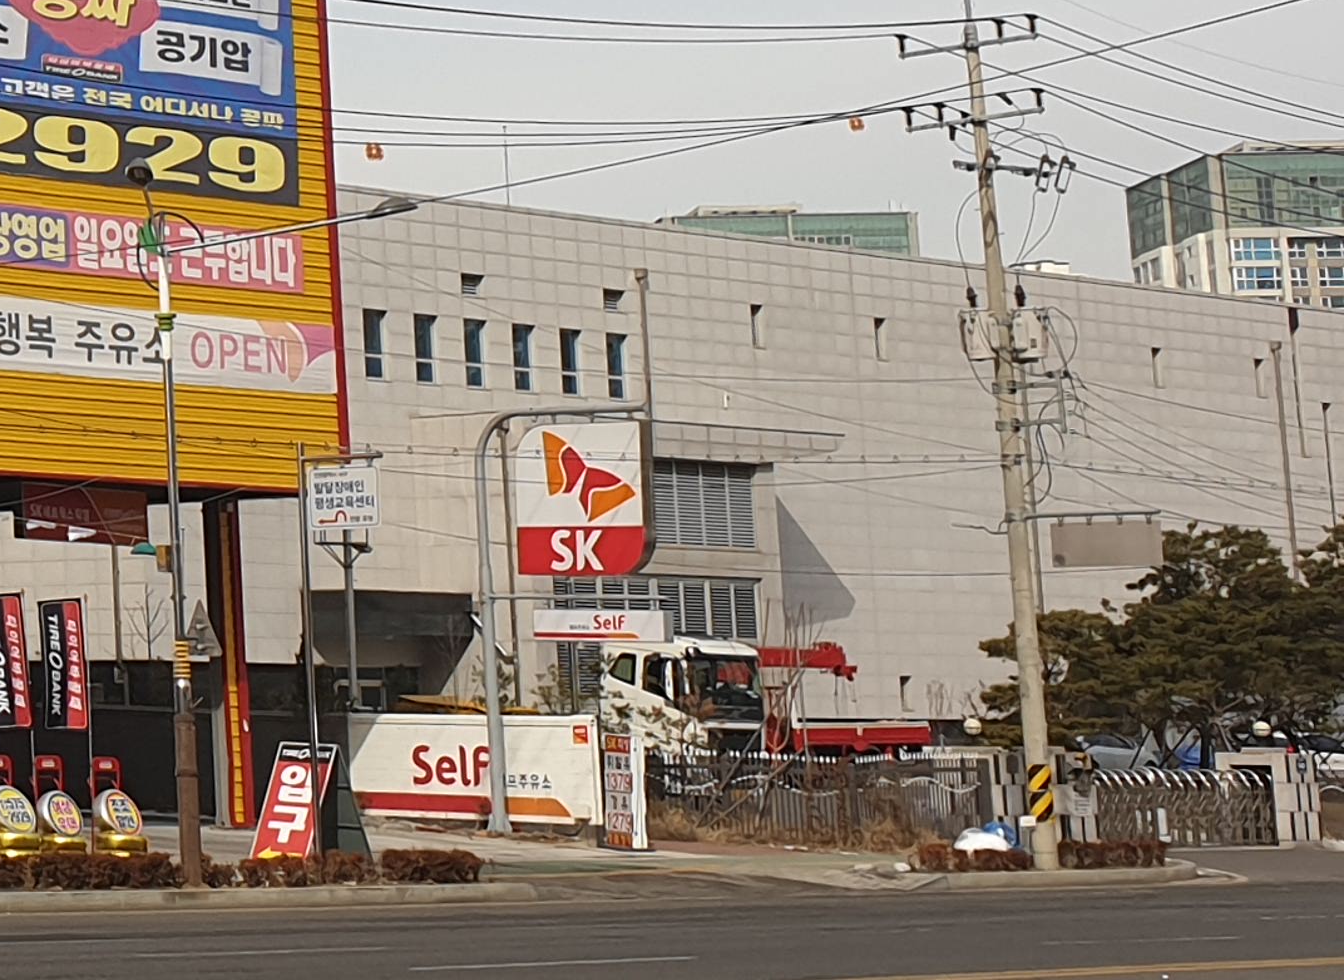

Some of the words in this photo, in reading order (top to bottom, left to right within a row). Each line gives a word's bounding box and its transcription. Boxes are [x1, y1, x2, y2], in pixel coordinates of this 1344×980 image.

[156, 27, 252, 74] 공기압
[0, 76, 75, 103] 고객은
[82, 87, 132, 109] 전국
[139, 94, 234, 124] 어디서나
[190, 330, 289, 376] OPEN
[550, 528, 604, 572] SK
[593, 614, 626, 630] Self
[411, 744, 491, 787] Self
[267, 765, 313, 844] 입구
